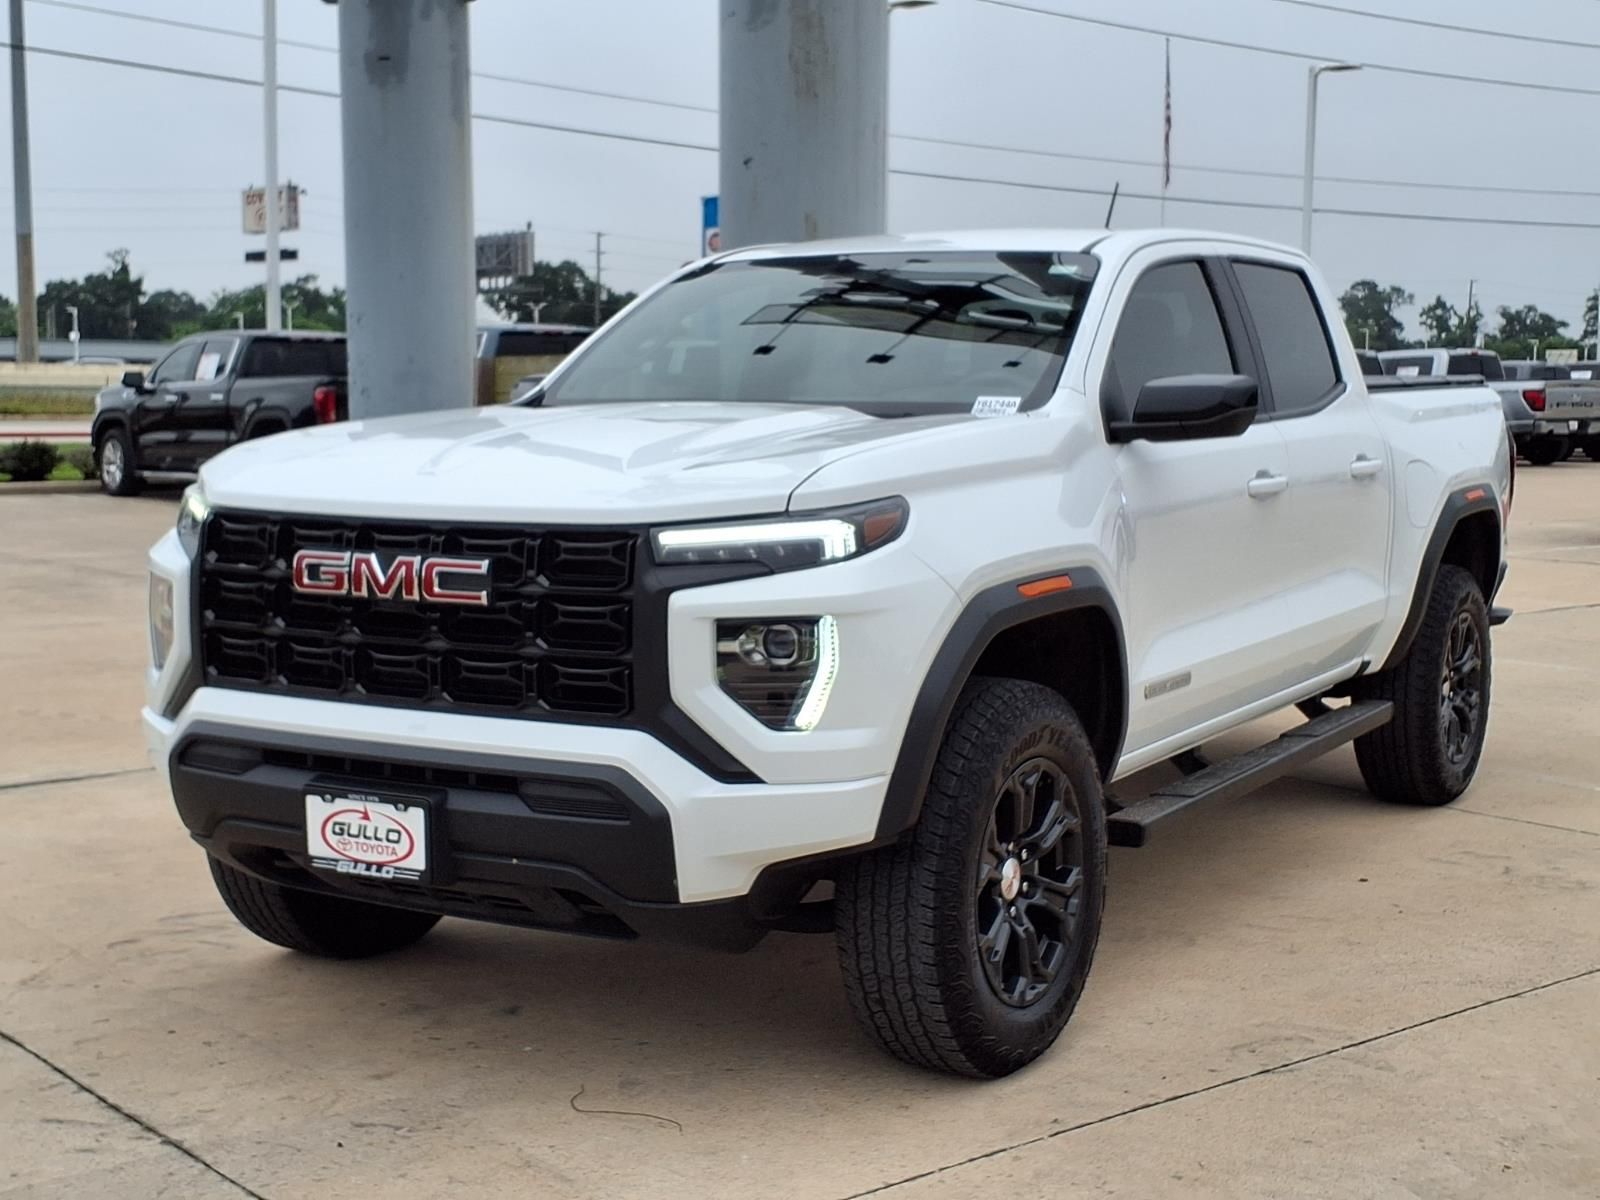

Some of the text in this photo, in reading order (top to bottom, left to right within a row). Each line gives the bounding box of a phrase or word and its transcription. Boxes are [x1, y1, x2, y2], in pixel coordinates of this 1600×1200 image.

[293, 549, 490, 606] GMC
[331, 821, 402, 844] GULLO
[355, 841, 398, 857] TOYOTA
[336, 860, 395, 878] GULLO
